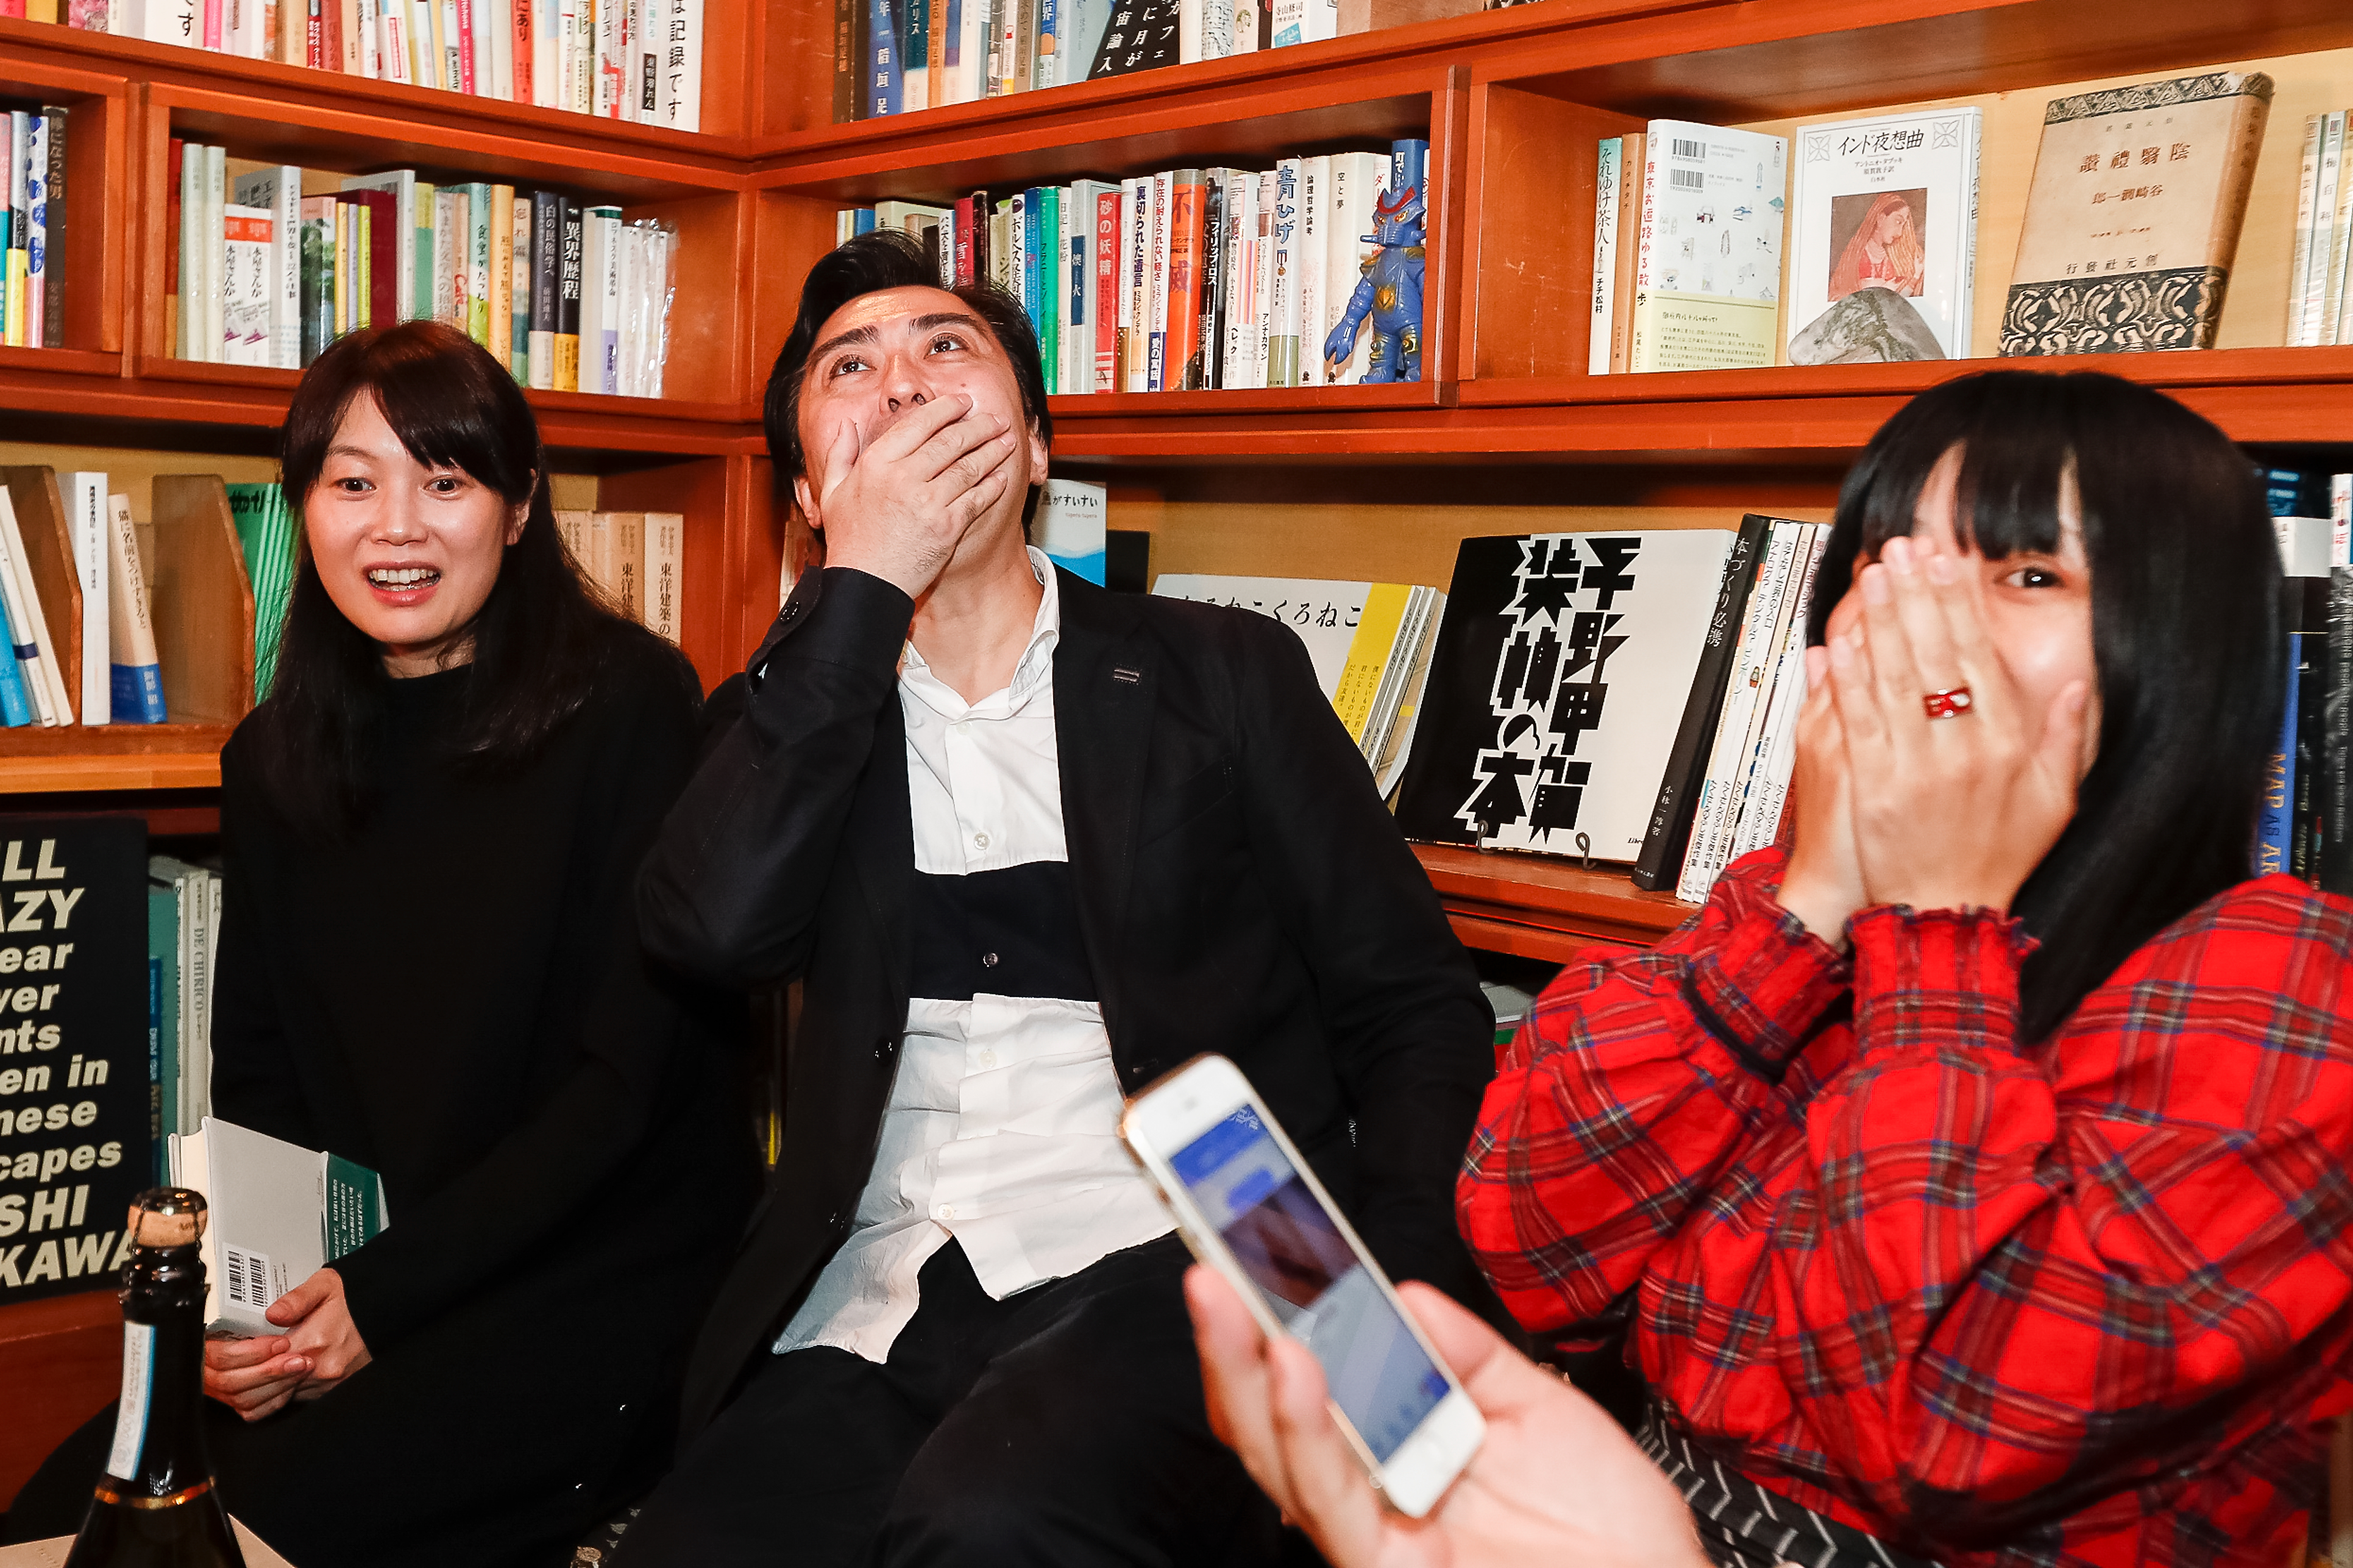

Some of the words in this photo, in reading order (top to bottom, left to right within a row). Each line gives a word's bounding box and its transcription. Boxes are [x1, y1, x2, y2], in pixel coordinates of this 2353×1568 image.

[668, 0, 686, 121] は記録です
[1098, 0, 1132, 74] 宙論入
[1125, 7, 1158, 68] に月が
[1837, 129, 1925, 156] インド夜想曲
[1275, 165, 1296, 245] 青ひげ
[1336, 172, 1345, 210] 空と夢
[1596, 147, 1613, 245] それゆけ茶人
[1624, 160, 1633, 209] カタチタチ
[562, 221, 581, 300] 異界歴程
[1099, 200, 1113, 276] 砂の妖精
[1134, 185, 1148, 288] 裏切られた遺言
[1154, 178, 1166, 282] 存在の耐えられない軽さ
[1208, 220, 1219, 286] フィリップ・ロス
[1637, 161, 1656, 307] 東京お遍路ゆる散歩
[1595, 278, 1604, 314] チチ松村
[1260, 313, 1269, 361] アンナ・カヴァン
[659, 562, 672, 635] 東洋建築の
[1706, 537, 1749, 648] 本づくり必携
[2268, 754, 2286, 809] MAP
[2, 839, 66, 882] LL
[0, 887, 85, 933] ZY
[194, 928, 205, 948] DE
[194, 950, 205, 1012] CHIRICO
[67, 1054, 109, 1088] in
